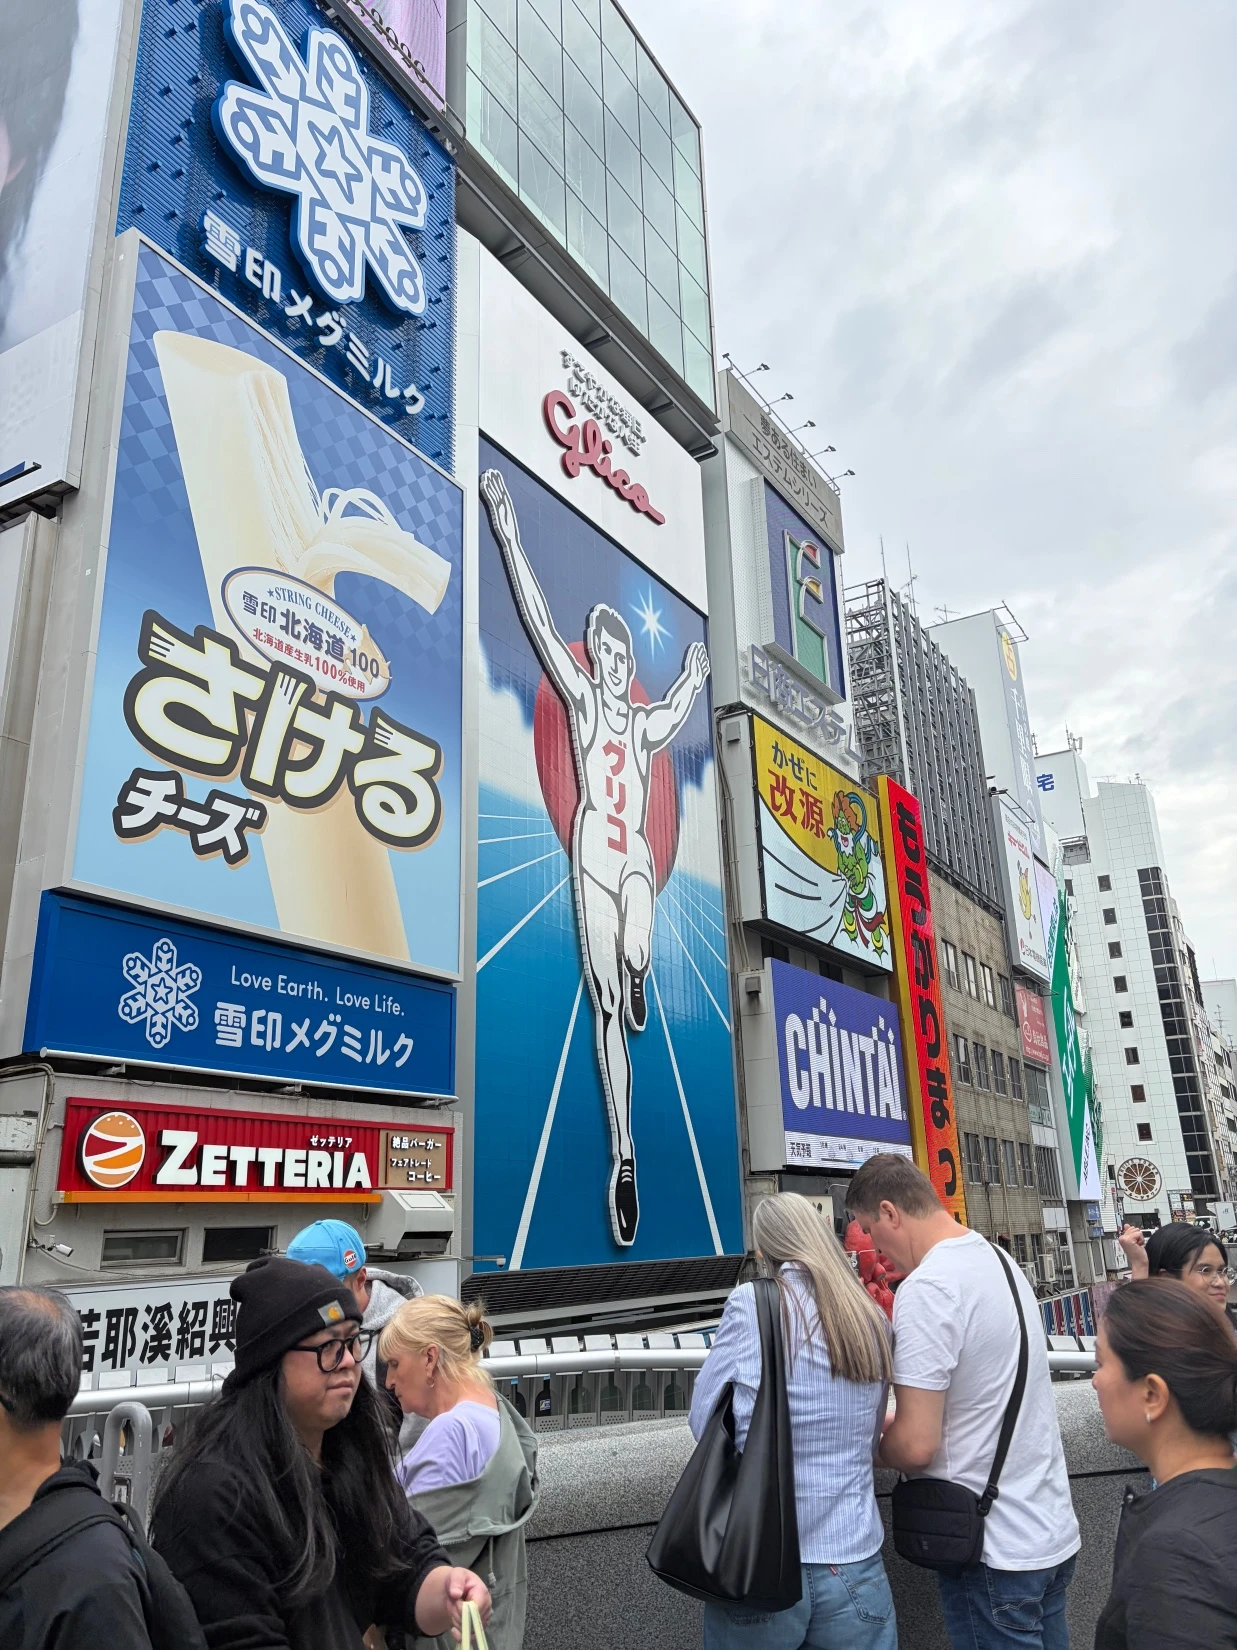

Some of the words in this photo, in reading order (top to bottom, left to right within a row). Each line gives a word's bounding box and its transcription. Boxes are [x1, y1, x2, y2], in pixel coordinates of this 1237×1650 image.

[201, 208, 426, 415] 雪印メグミルク
[543, 390, 665, 524] Glico
[752, 432, 829, 529] エステムシリーズ
[760, 413, 817, 488] 夢ある住まい
[275, 587, 312, 610] STRING
[315, 602, 352, 639] CHEESE
[253, 628, 366, 693] 北海道産生乳100%使用
[124, 613, 441, 842] さける
[602, 738, 628, 857] グリコ
[772, 740, 818, 791] かぜに
[1036, 773, 1055, 792] 宅
[117, 772, 264, 860] チーズ
[767, 769, 826, 840] 改源
[231, 965, 272, 991] Love
[278, 975, 329, 1002] Earth.
[336, 986, 370, 1010] Love
[374, 994, 405, 1016] Life.
[896, 801, 963, 1224] もうかりまっ
[214, 1001, 414, 1068] 雪印メグミルク
[785, 996, 903, 1121] CHINTAI
[156, 1129, 373, 1188] ZETTERIA
[310, 1135, 353, 1148] ゼッテリア
[391, 1158, 432, 1168] フェアトレード
[392, 1136, 442, 1150] 絶品バーガー
[408, 1171, 441, 1182] コーヒー
